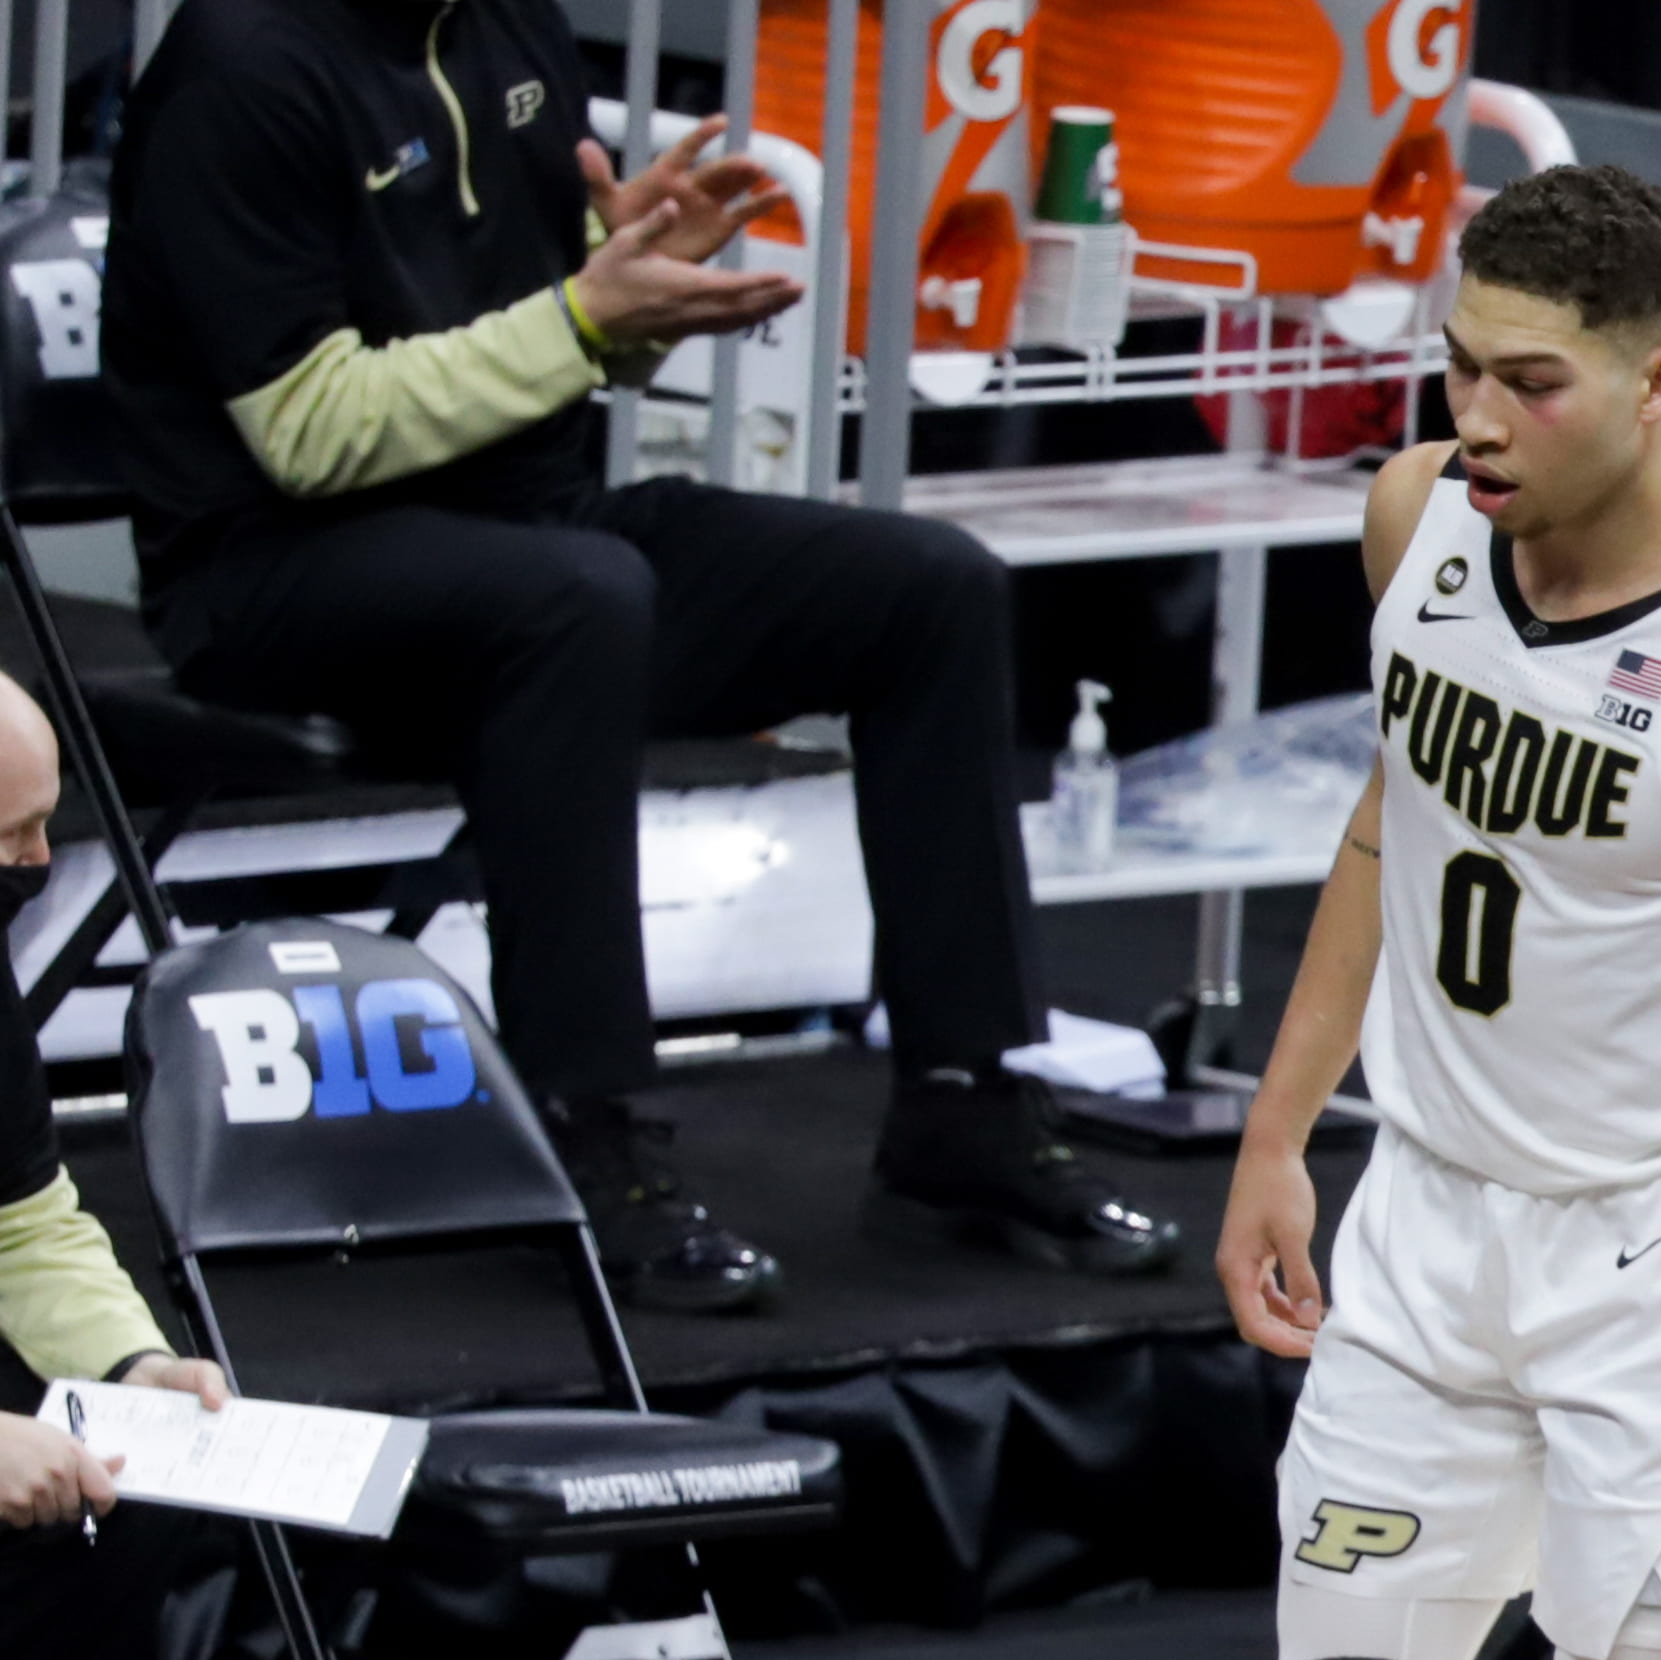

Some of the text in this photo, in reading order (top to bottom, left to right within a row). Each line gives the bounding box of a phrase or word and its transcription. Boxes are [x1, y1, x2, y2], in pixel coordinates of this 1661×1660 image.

[1380, 648, 1642, 841] PURDUE
[1435, 848, 1524, 1020] 0
[561, 1459, 801, 1514] BASKETBALL TOURNAMENT
[1294, 1498, 1422, 1574] P
